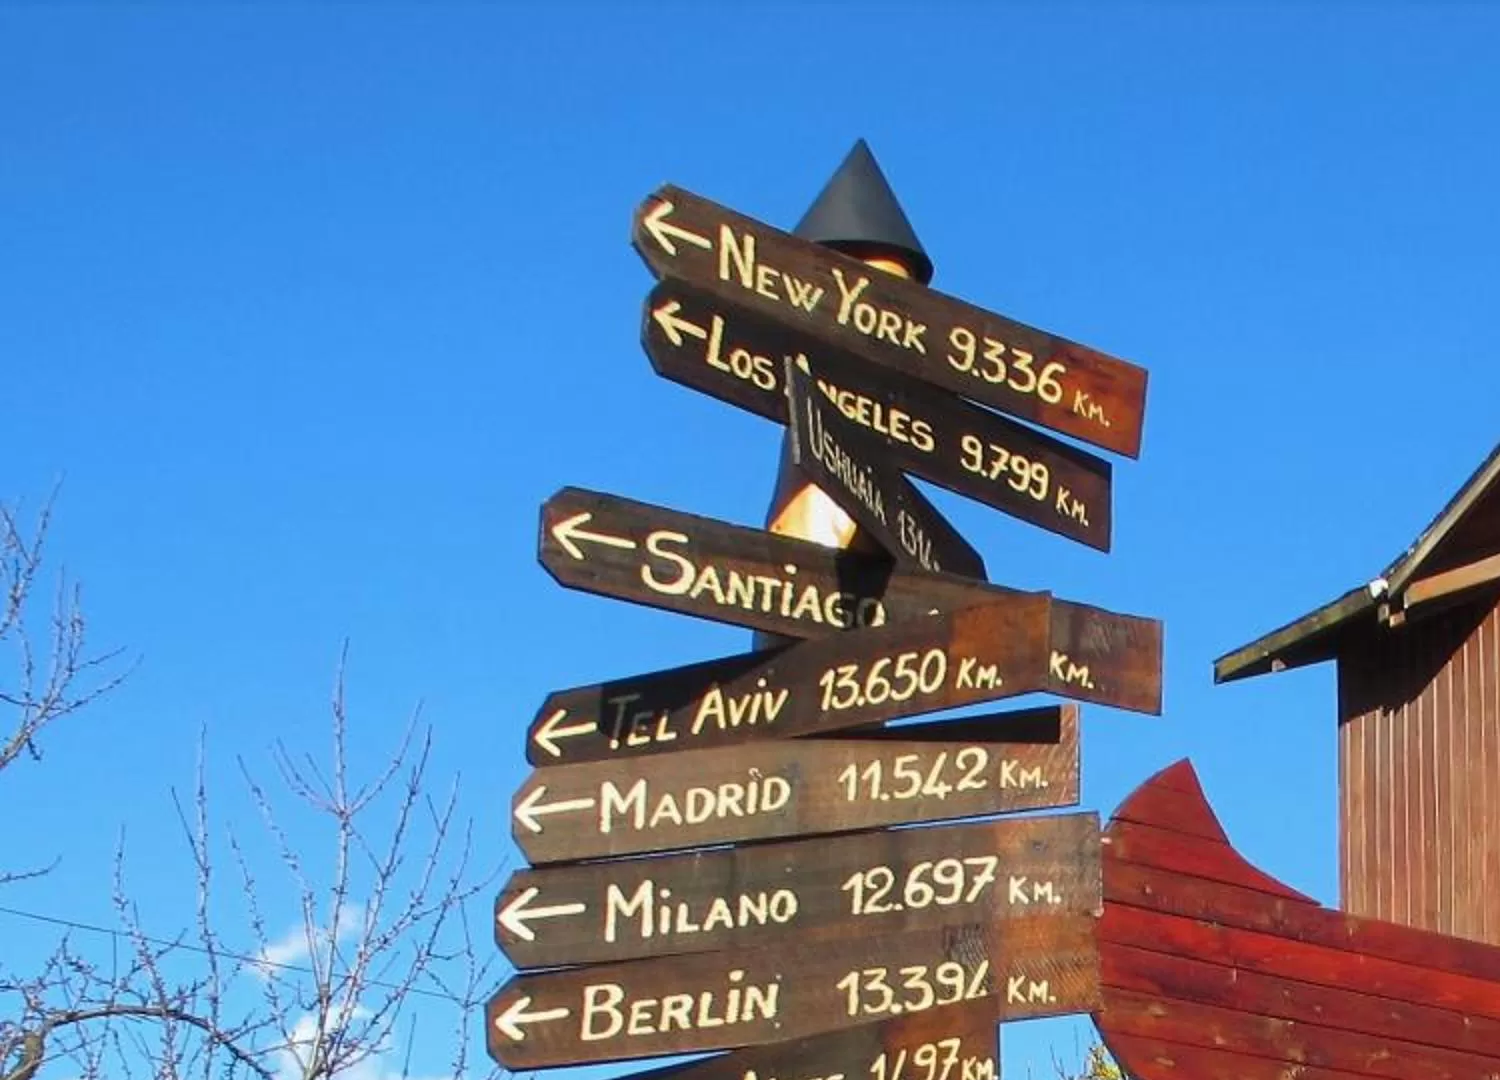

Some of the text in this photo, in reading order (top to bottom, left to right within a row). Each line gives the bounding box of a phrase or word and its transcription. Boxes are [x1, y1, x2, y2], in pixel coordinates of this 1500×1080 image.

[718, 224, 825, 314] NEW
[832, 268, 928, 355] YORK
[948, 327, 1066, 405] 9.336
[706, 315, 778, 390] LOS
[785, 353, 935, 453] NGELES
[960, 435, 1050, 500] 9.799
[607, 693, 677, 750] TEL
[691, 677, 789, 736] AVIV
[819, 649, 947, 711] 13.650
[600, 768, 791, 834] MADRID
[837, 747, 988, 802] 11.542
[604, 878, 798, 943] MILANO
[841, 855, 999, 915] 12.697
[580, 968, 781, 1042] BERLIN
[836, 959, 990, 1016] 13.394
